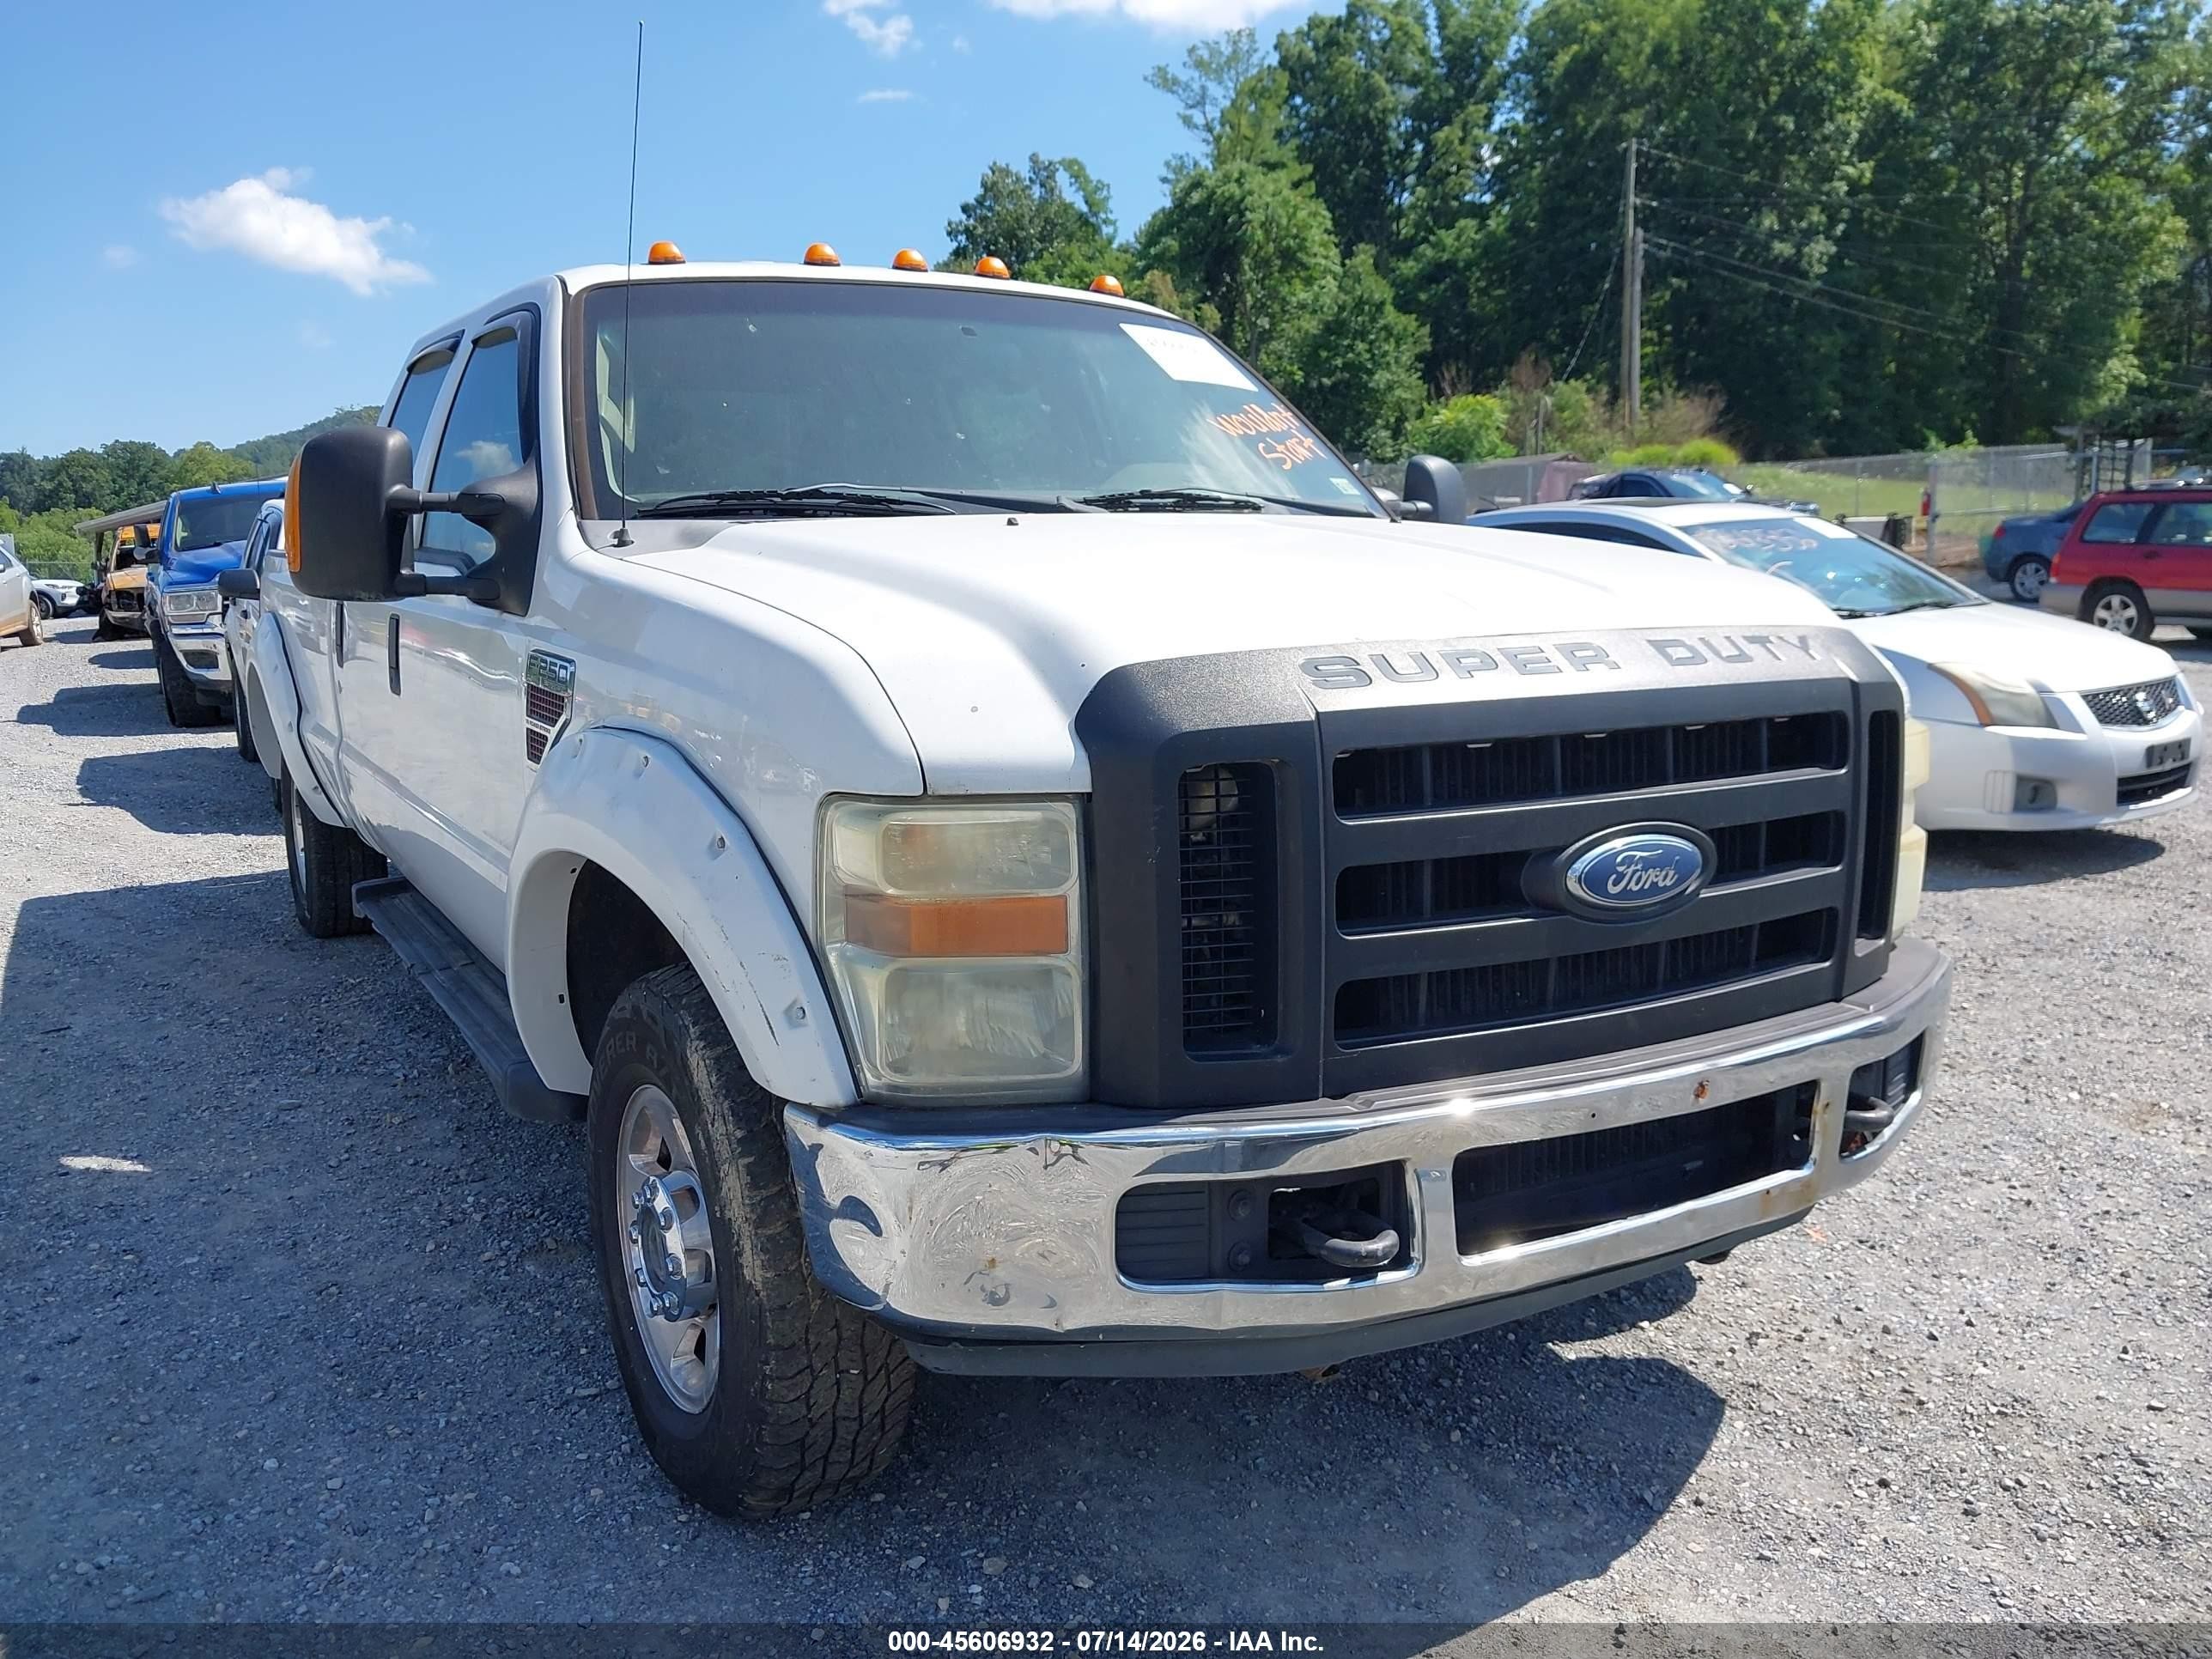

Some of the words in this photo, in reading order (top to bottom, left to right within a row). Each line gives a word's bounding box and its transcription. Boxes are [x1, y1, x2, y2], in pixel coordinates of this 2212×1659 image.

[1298, 642, 1621, 690] SUPER
[1645, 635, 1821, 666] DUTY
[1607, 849, 1680, 895] Ford
